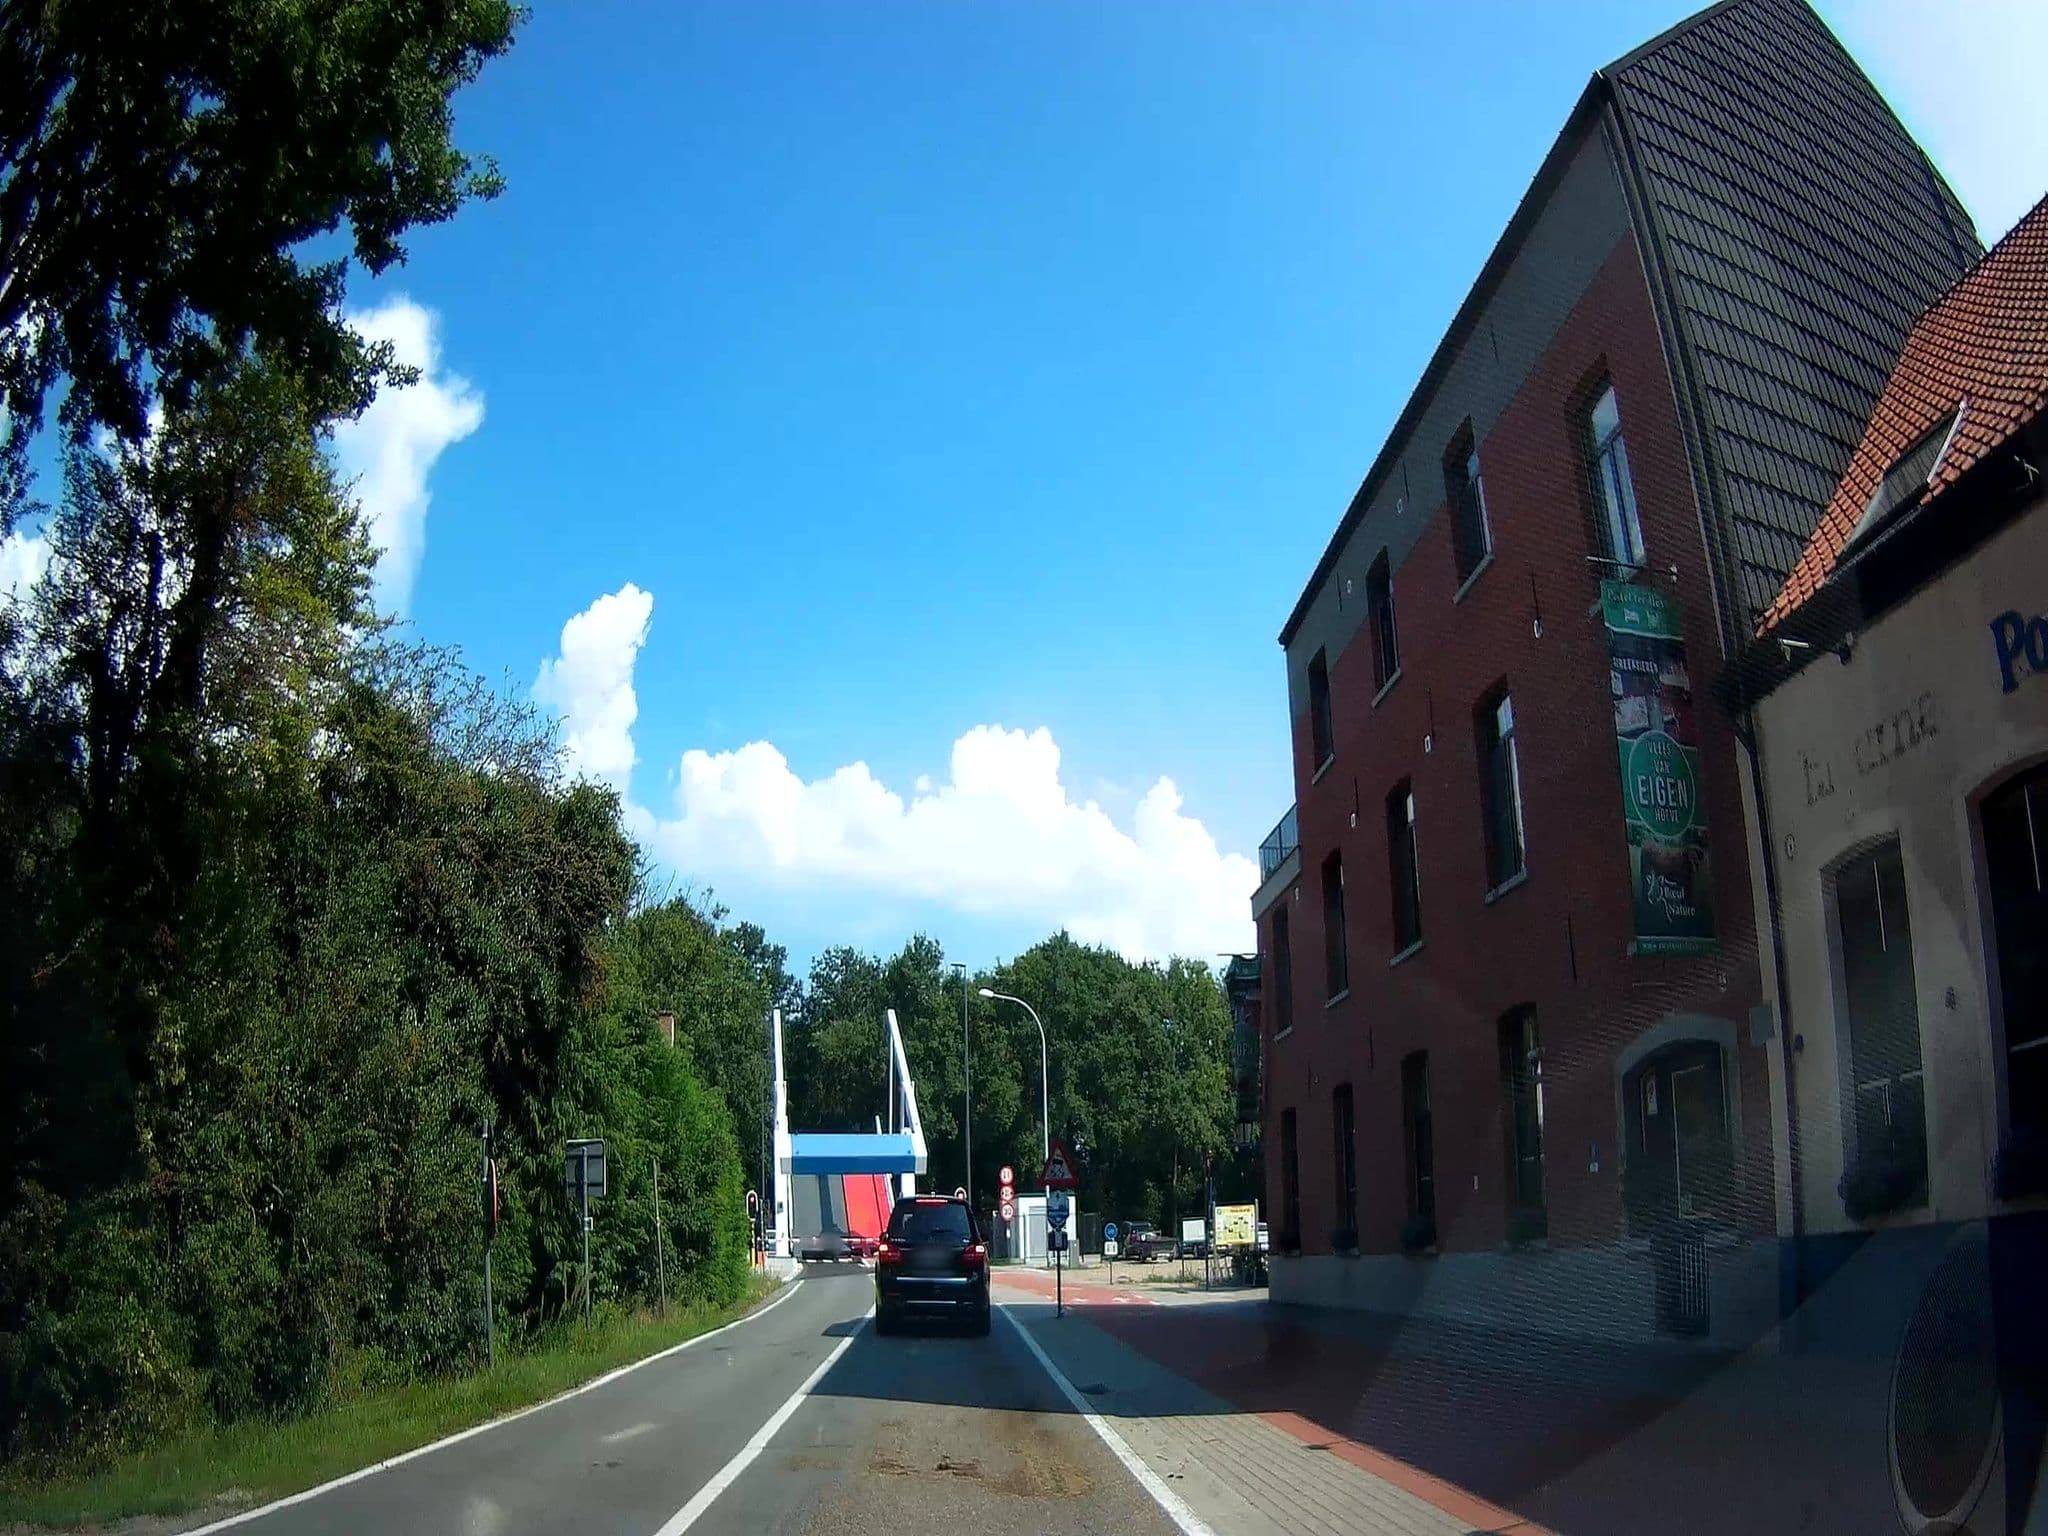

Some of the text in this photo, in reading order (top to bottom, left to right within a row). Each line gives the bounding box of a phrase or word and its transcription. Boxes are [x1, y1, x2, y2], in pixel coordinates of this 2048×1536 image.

[1648, 741, 1672, 755] VLEES
[1654, 759, 1671, 773] VAN
[1637, 774, 1688, 808] EIGEN
